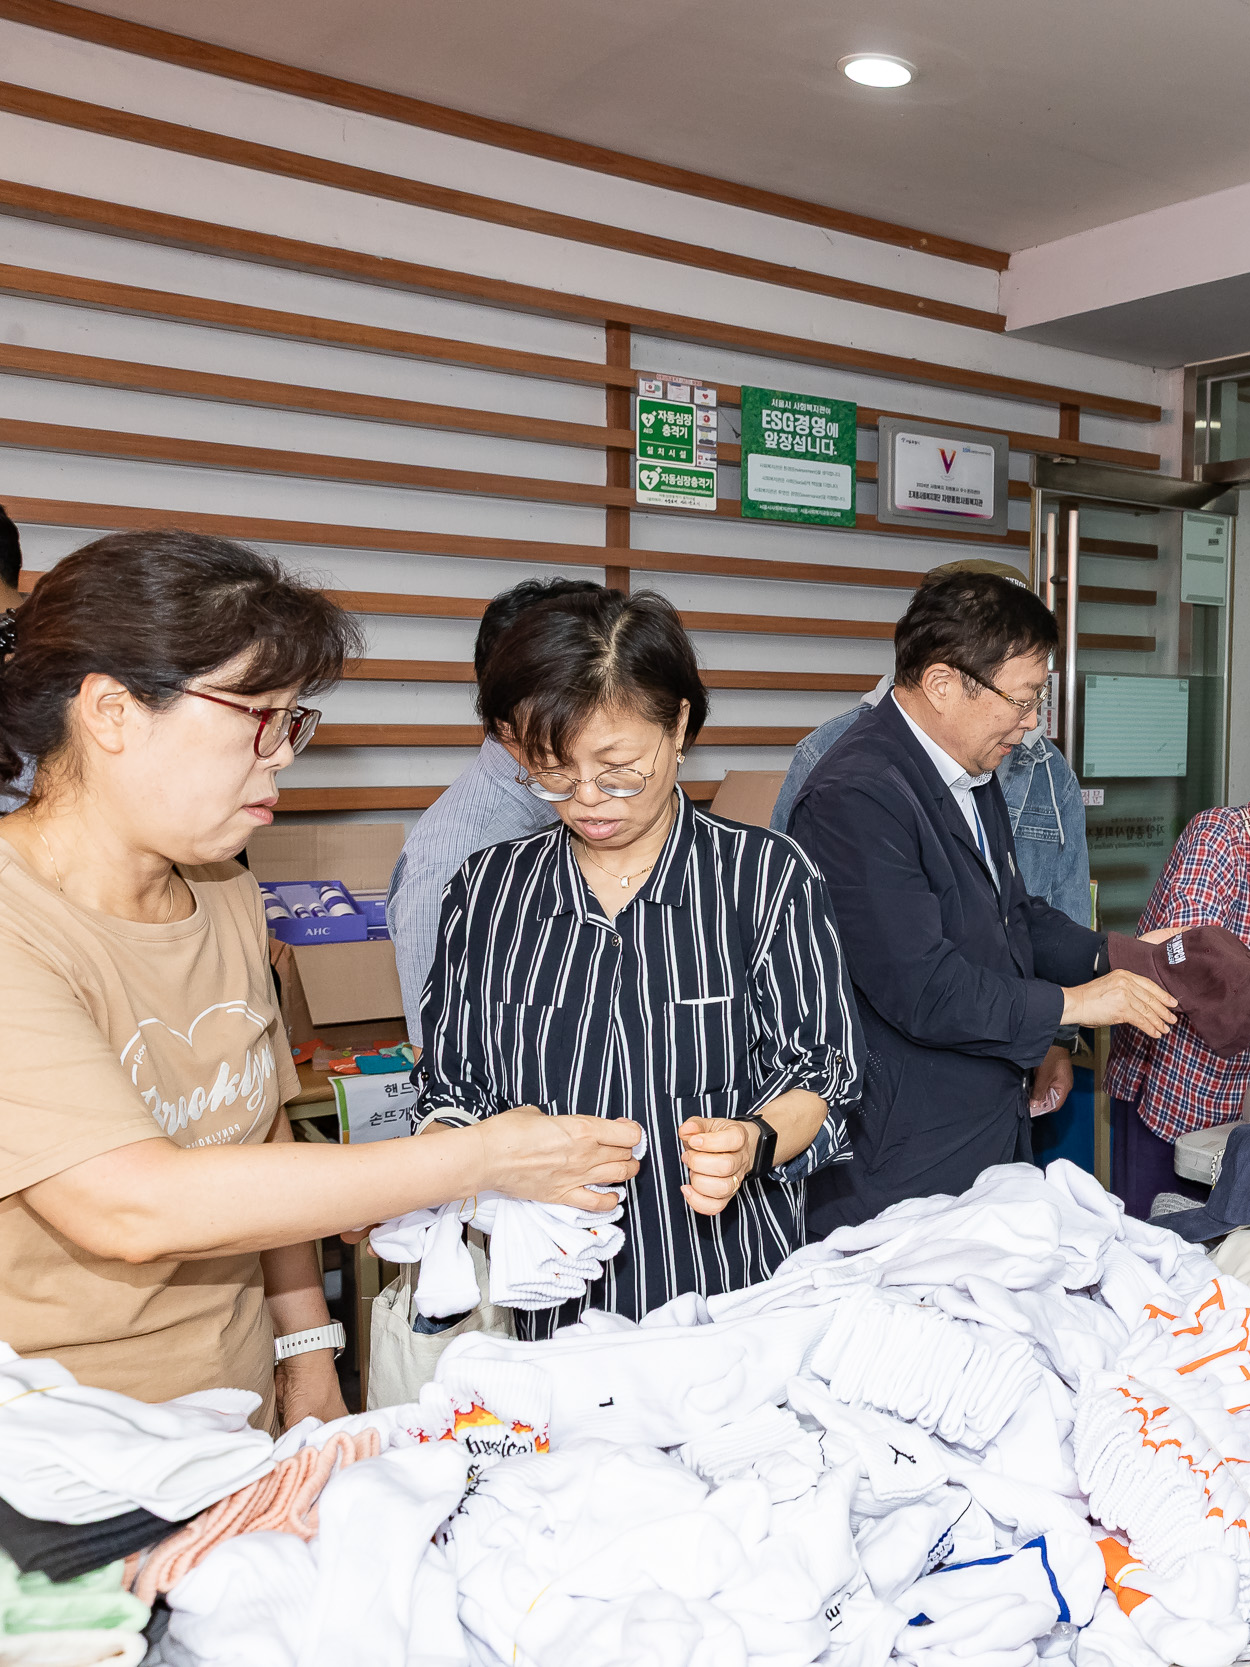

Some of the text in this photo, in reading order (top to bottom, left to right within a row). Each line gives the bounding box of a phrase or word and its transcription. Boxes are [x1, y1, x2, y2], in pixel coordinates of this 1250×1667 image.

[657, 410, 693, 426] 자동심장
[761, 409, 839, 438] ESG경영에
[661, 423, 688, 439] 충격기
[764, 431, 837, 456] 앞장섭니다.
[660, 473, 713, 489] 자동심장충격기
[305, 927, 330, 936] AHC
